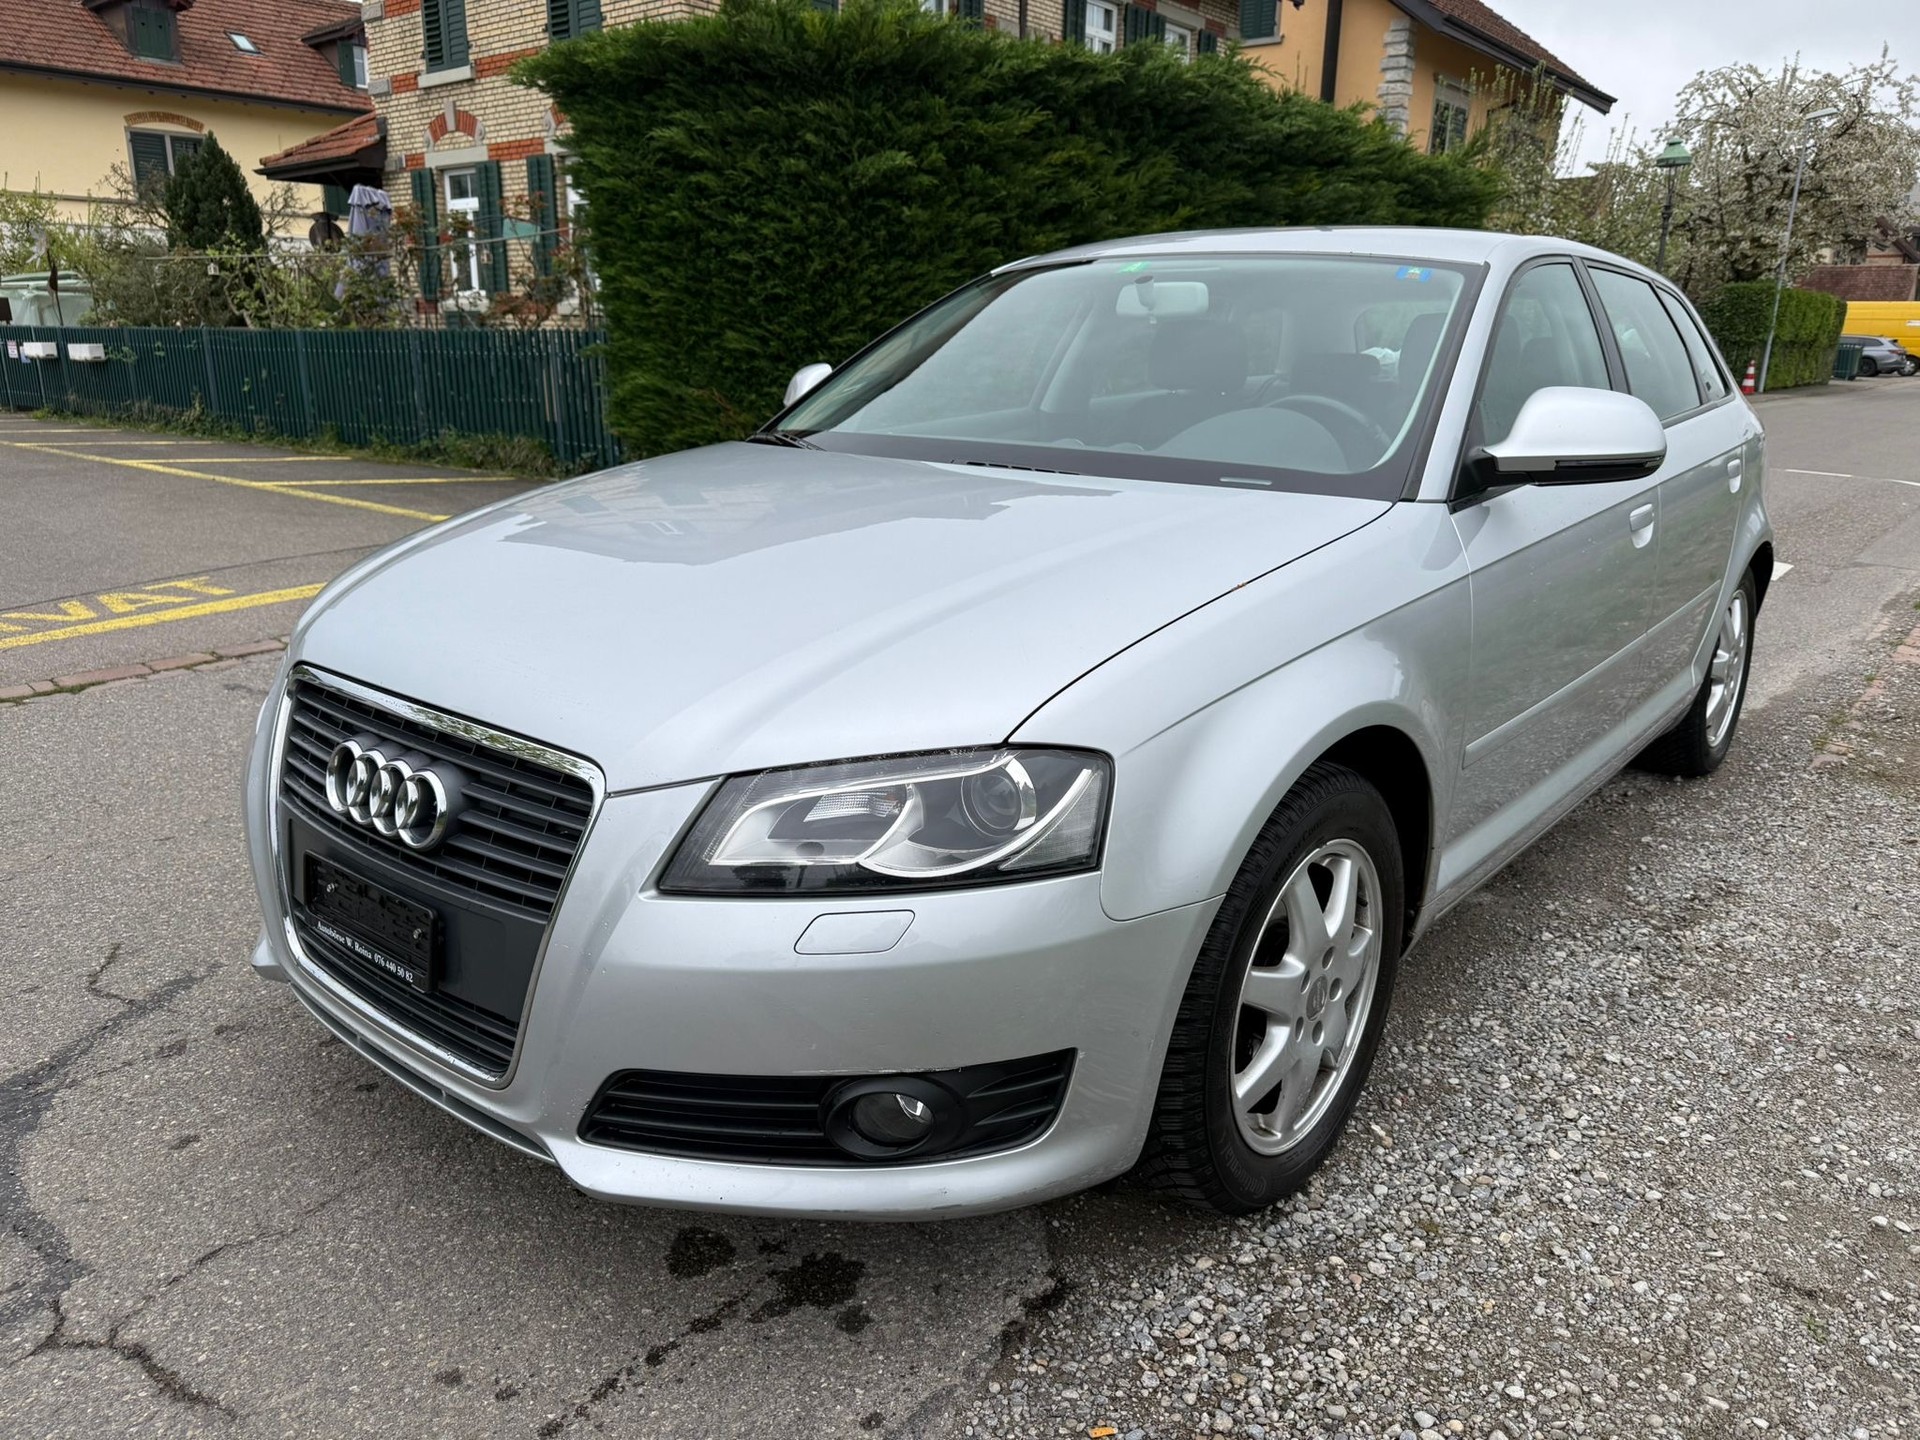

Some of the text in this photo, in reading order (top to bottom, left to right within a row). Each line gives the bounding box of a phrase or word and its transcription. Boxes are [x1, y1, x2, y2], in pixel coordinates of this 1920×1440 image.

[374, 952, 385, 967] 076
[397, 965, 405, 978] 50
[405, 971, 413, 983] 82
